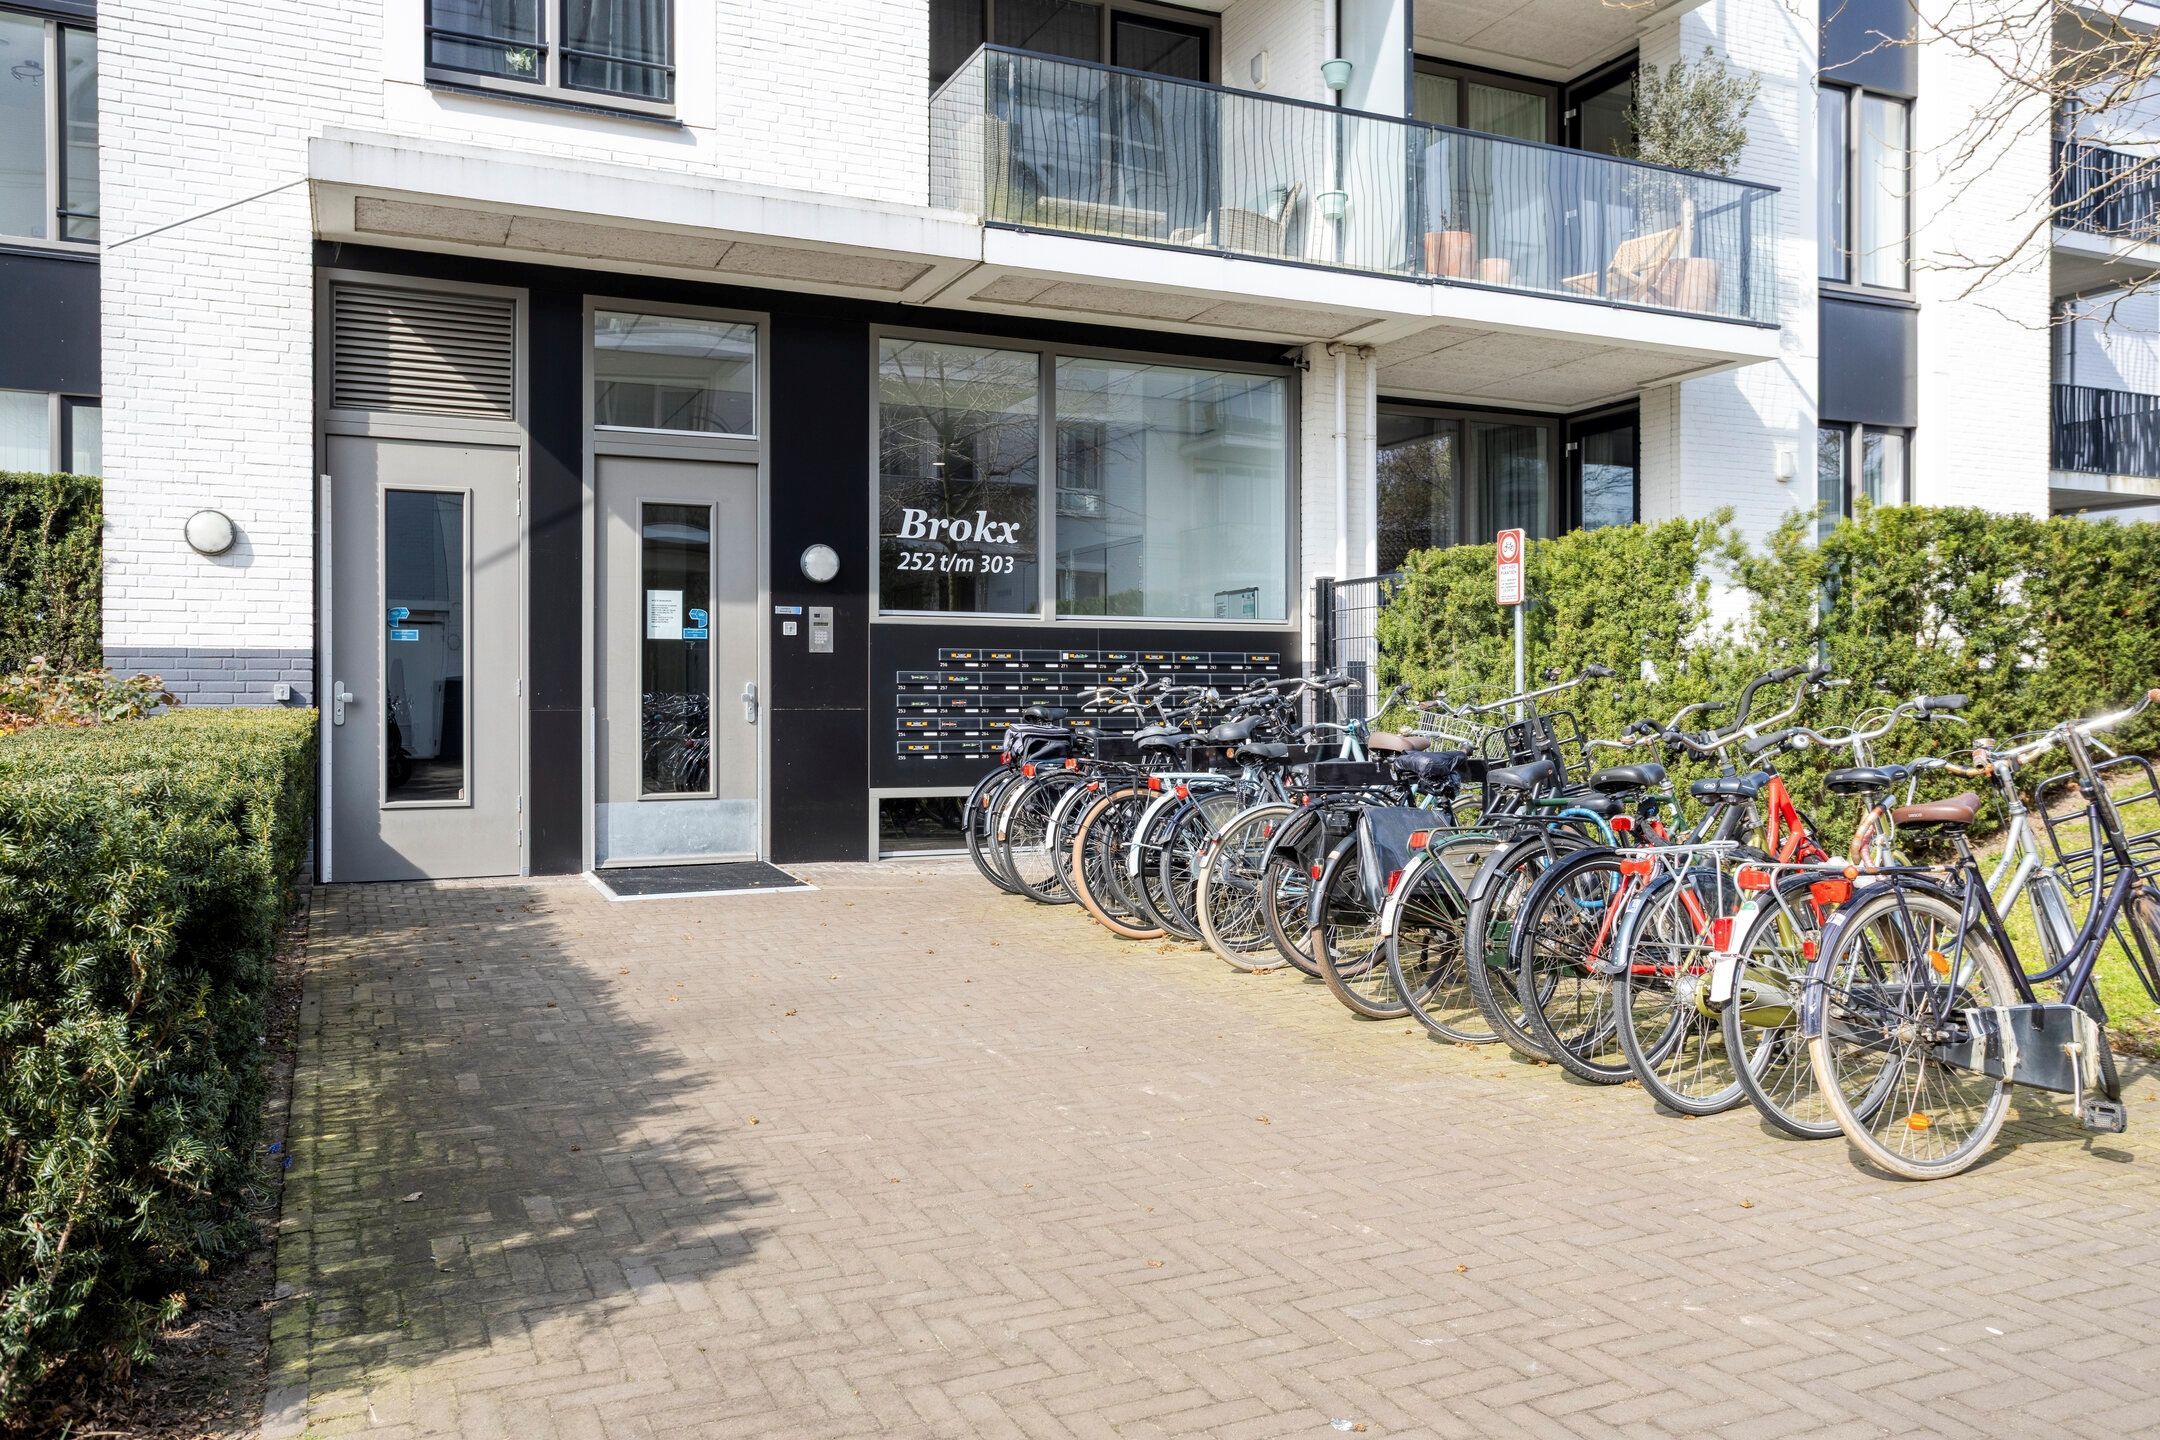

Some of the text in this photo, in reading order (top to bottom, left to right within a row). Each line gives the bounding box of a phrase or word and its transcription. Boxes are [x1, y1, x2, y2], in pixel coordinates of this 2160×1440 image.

[897, 508, 1020, 544] Brokx
[897, 552, 1014, 574] 252 t/m 303
